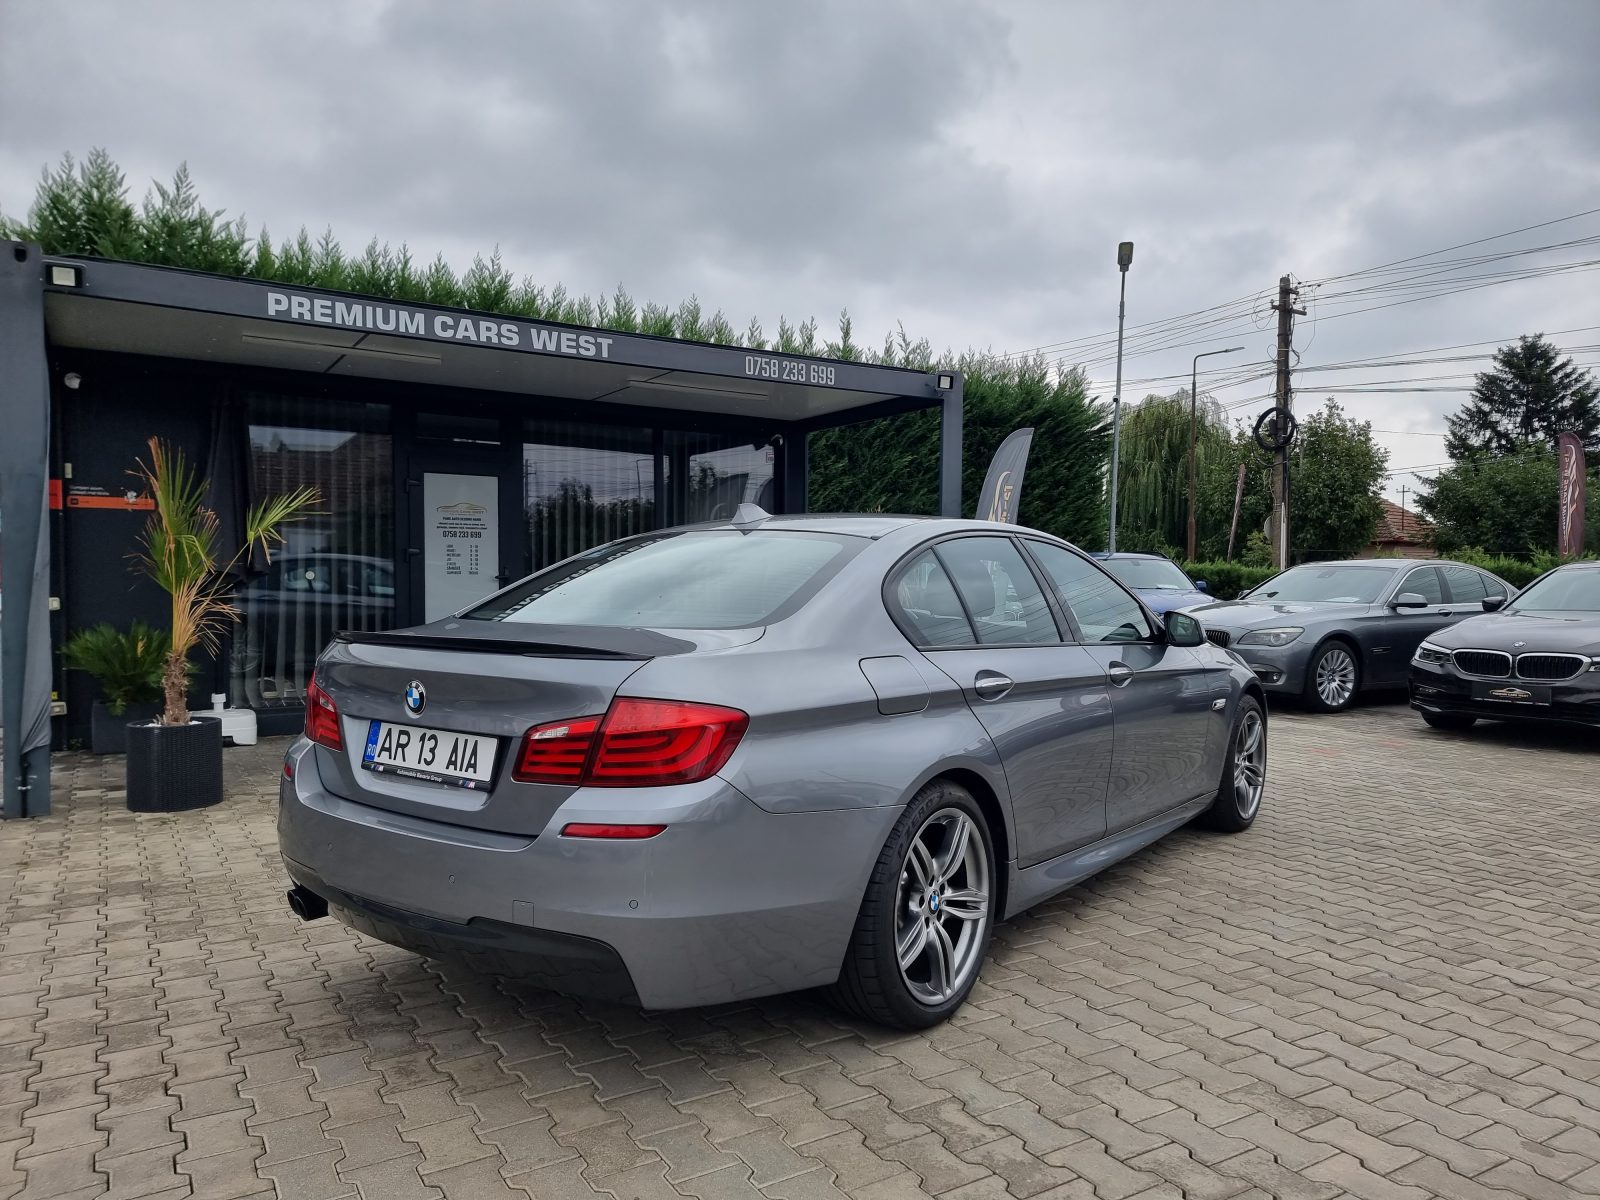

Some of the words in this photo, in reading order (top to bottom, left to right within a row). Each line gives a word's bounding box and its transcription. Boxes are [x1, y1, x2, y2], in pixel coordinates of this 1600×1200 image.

[267, 292, 425, 335] PREMIUM
[433, 315, 520, 346] CARS
[530, 328, 613, 359] WEST
[745, 355, 779, 378] 0758
[782, 361, 806, 382] 233
[810, 365, 835, 385] 699
[367, 743, 377, 756] RO
[377, 728, 411, 762] AR
[417, 732, 439, 766] 13
[445, 737, 479, 774] AIA
